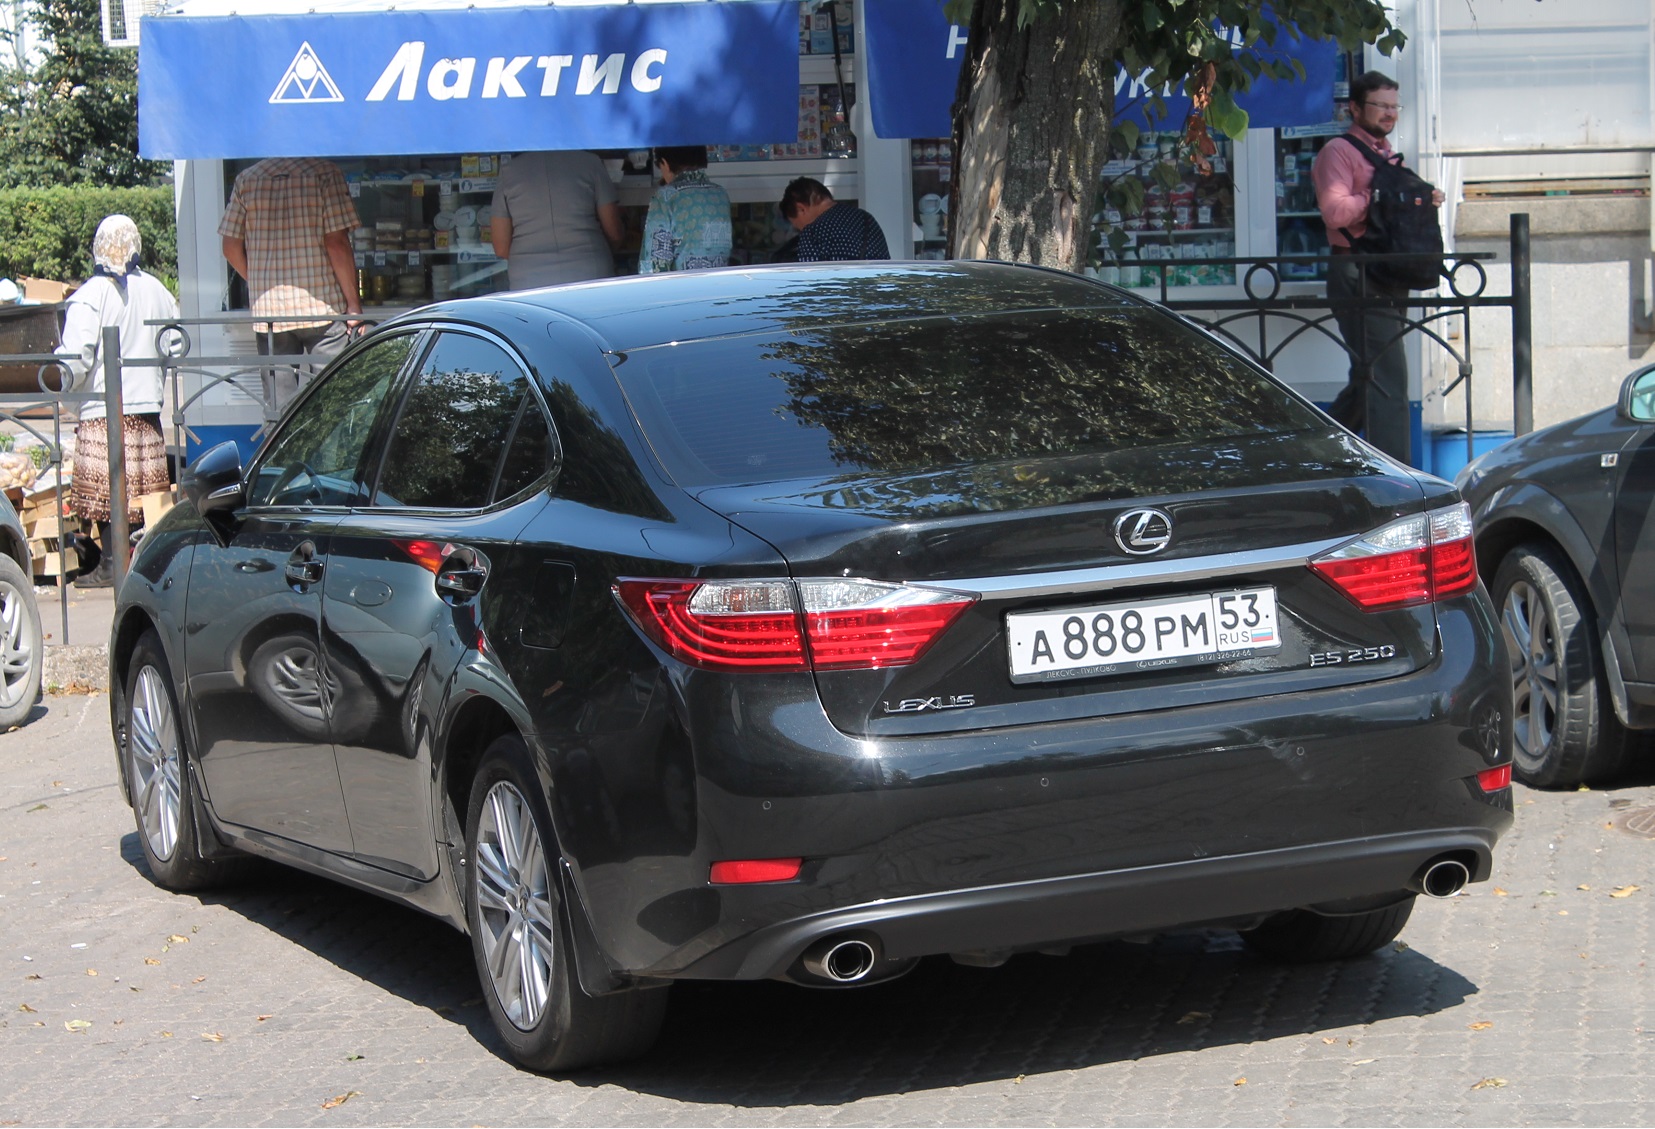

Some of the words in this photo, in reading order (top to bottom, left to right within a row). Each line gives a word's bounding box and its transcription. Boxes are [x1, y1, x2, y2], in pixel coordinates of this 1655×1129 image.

[364, 41, 668, 101] Лактис
[1219, 594, 1260, 629] 53
[1219, 630, 1250, 645] RUS
[1309, 651, 1342, 667] ES
[1348, 644, 1396, 662] 250
[883, 694, 976, 713] LEXUS
